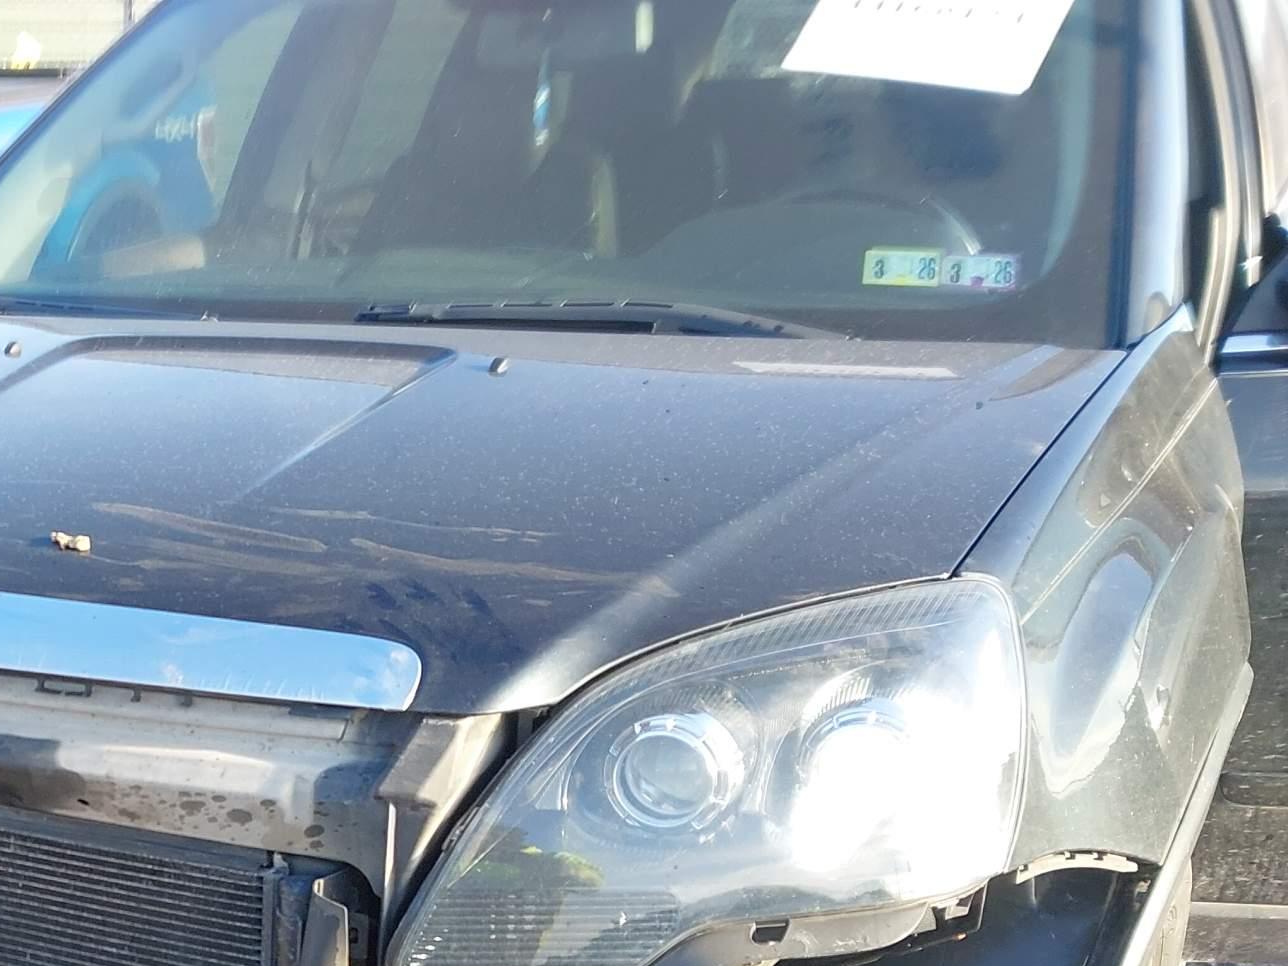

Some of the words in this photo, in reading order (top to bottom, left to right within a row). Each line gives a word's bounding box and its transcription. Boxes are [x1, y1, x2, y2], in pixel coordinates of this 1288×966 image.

[872, 259, 885, 279] 3
[917, 257, 937, 281] 26
[950, 263, 962, 283] 3
[993, 261, 1012, 284] 26
